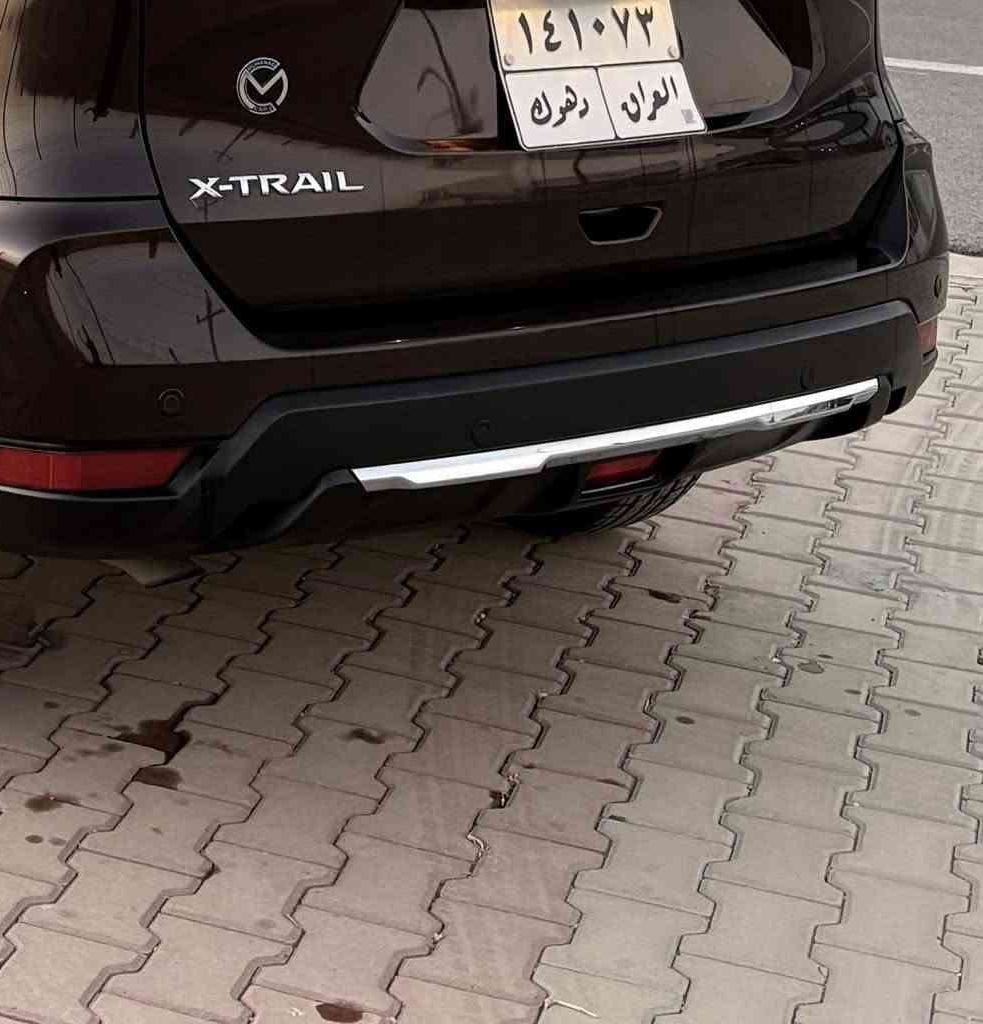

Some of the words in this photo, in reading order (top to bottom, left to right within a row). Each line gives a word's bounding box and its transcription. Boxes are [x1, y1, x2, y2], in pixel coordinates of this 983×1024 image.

[518, 5, 655, 55] ١٤١٠٧٣
[530, 85, 590, 128] دهوك
[620, 75, 679, 123] العراق
[189, 171, 364, 201] X-TRAIL
